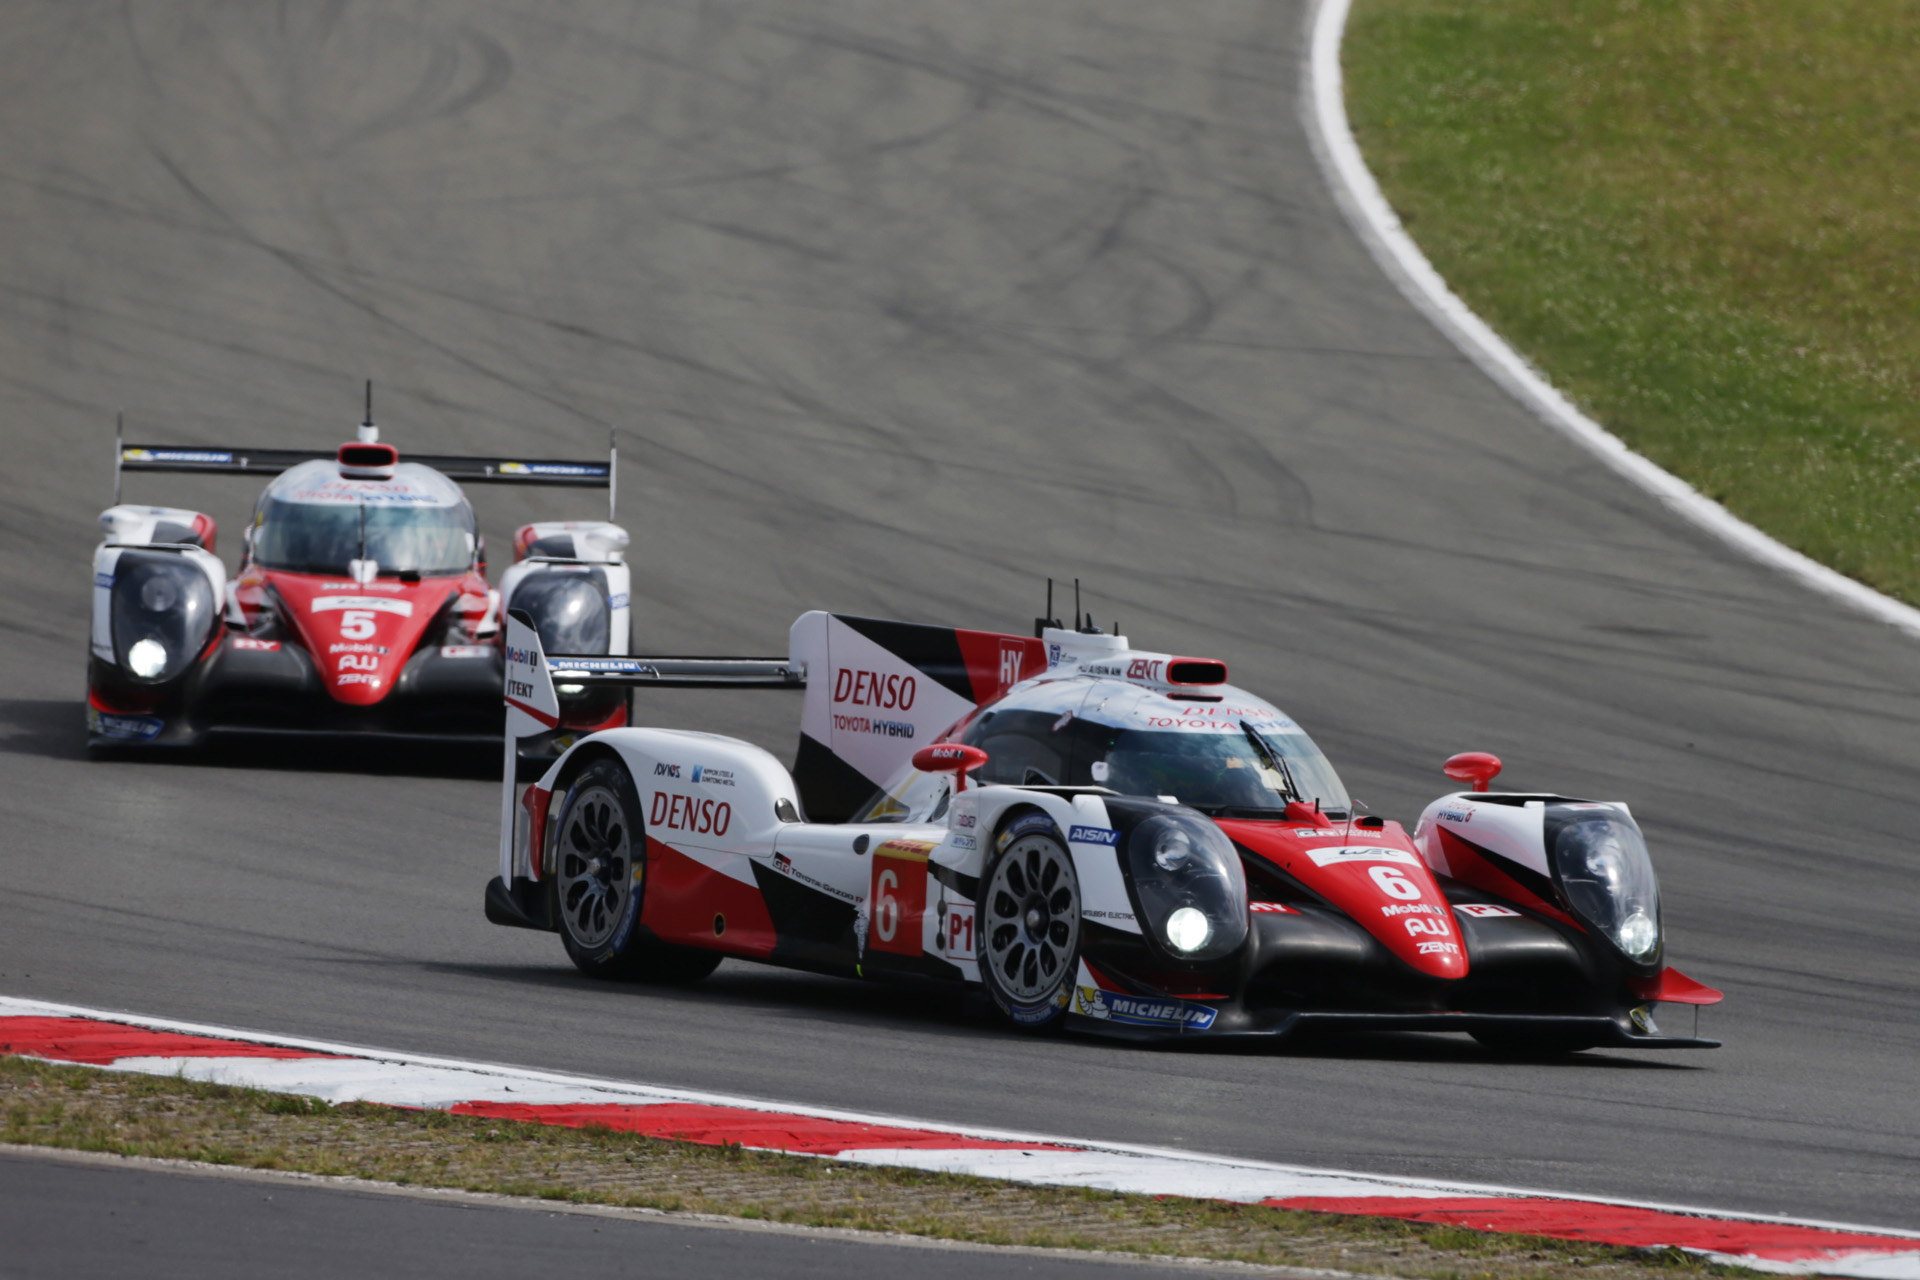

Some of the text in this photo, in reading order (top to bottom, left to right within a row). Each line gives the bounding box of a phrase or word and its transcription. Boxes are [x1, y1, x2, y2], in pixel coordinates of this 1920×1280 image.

[340, 611, 376, 640] 5
[507, 646, 529, 665] Mobil
[558, 661, 636, 670] MICHELIN
[1001, 649, 1023, 685] HY
[1126, 658, 1163, 681] ZENT
[507, 679, 534, 699] JTEKT
[833, 668, 916, 711] DENSO
[1182, 707, 1274, 718] DENSO
[833, 715, 914, 739] TOYOTA HYBRID
[1147, 717, 1238, 730] TOYOTA
[931, 748, 955, 759] Mobil
[650, 791, 731, 836] DENSO
[1071, 827, 1117, 844] AISIN
[773, 859, 791, 874] GR
[1368, 866, 1421, 900] 6
[876, 868, 898, 942] 6
[1381, 903, 1431, 917] Mobil
[949, 912, 973, 952] P1
[1416, 942, 1458, 954] ZENT
[1112, 999, 1211, 1024] MICHELIN
